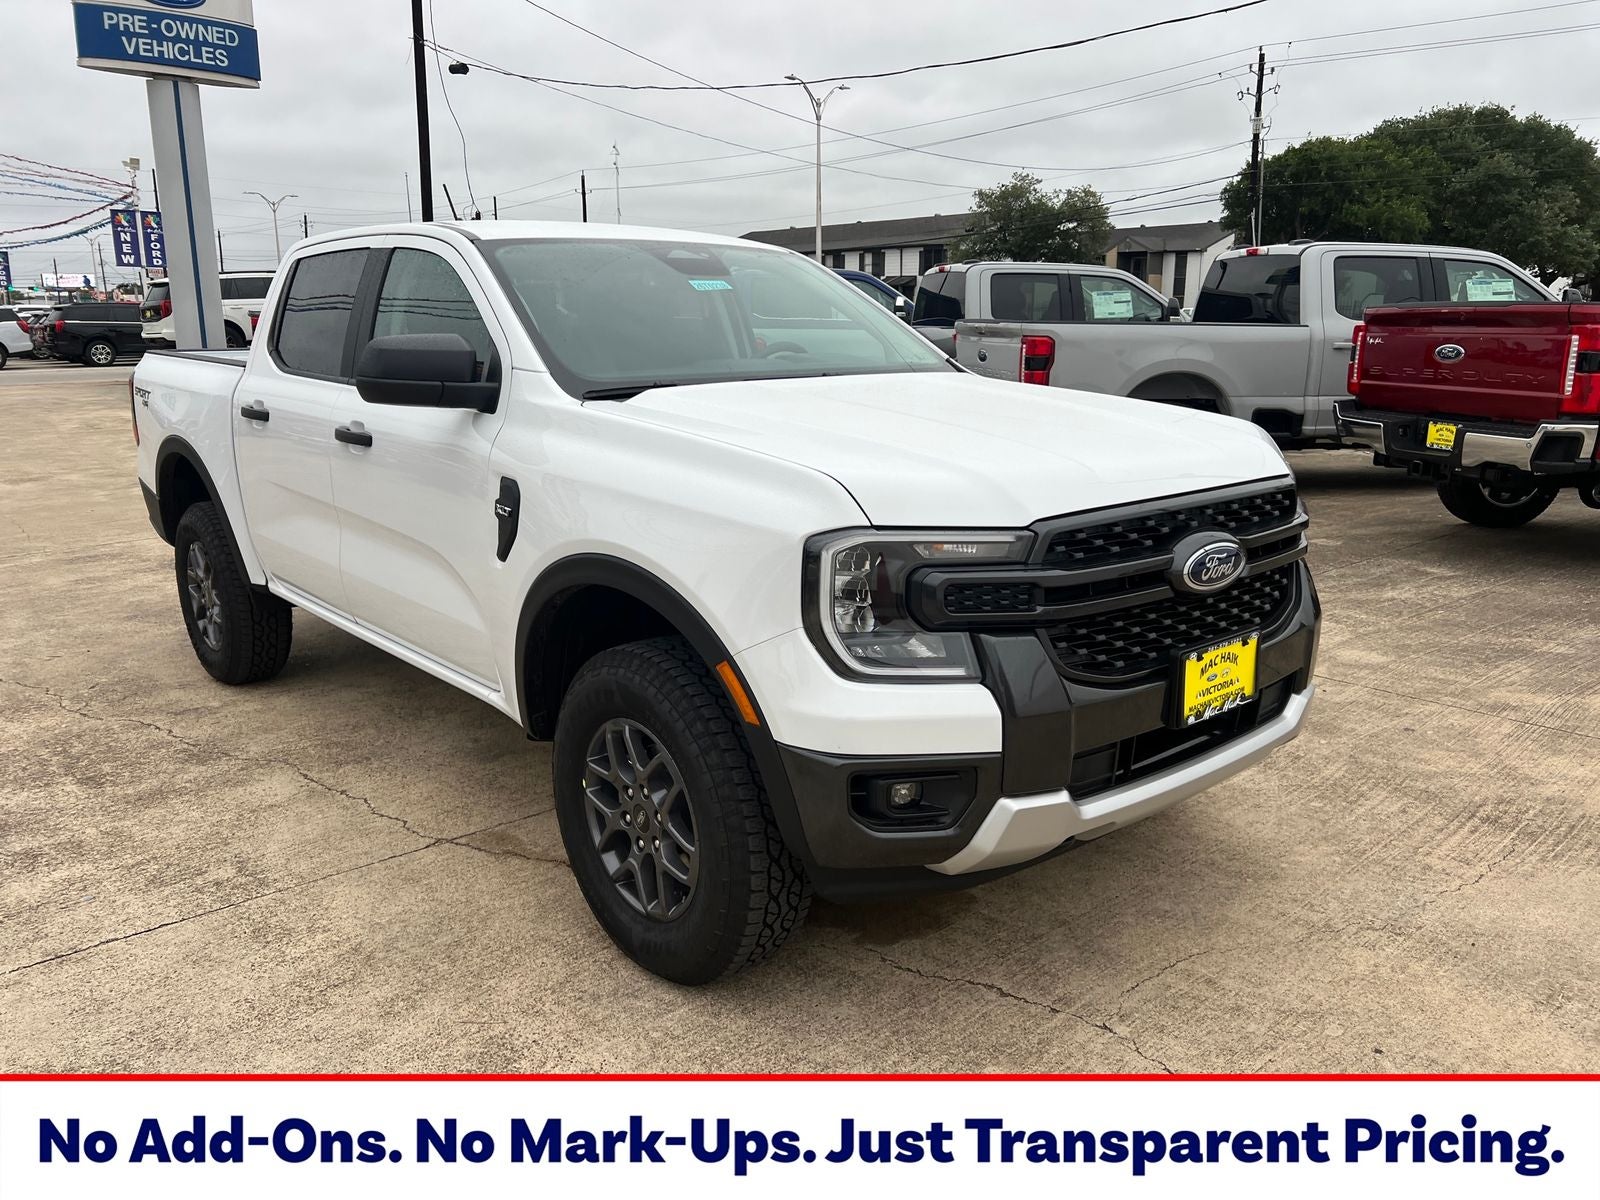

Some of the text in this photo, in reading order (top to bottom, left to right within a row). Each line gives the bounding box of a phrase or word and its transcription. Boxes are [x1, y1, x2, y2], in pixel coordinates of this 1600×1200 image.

[121, 36, 229, 67] VEHICLES
[120, 232, 134, 264] NEW
[150, 233, 163, 265] FORD
[1369, 366, 1454, 379] SUPER
[1463, 370, 1546, 384] DUTY
[1202, 553, 1235, 580] Ford
[1199, 655, 1219, 680] MAC
[1219, 651, 1239, 666] HAIK
[1200, 678, 1235, 698] VICTORIA
